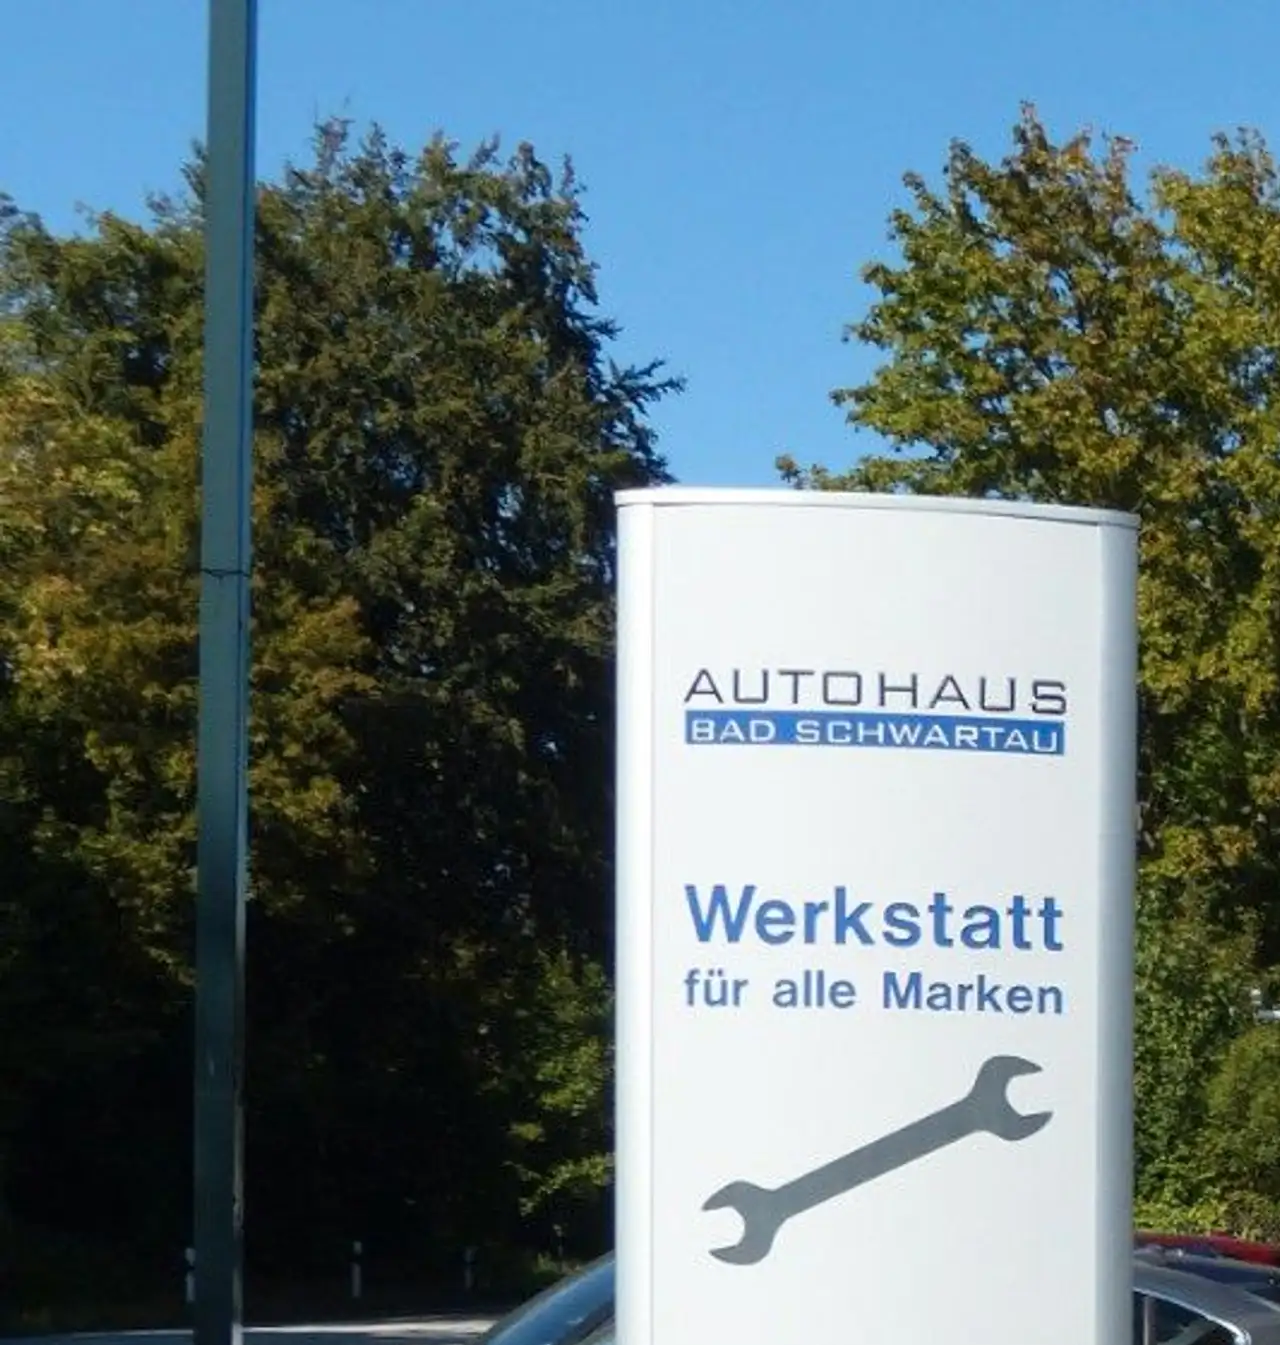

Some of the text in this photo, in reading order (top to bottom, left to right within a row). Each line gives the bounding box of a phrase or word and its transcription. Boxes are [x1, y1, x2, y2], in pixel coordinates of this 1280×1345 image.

[684, 668, 1067, 716] AUTOHAUS
[690, 719, 1059, 753] BAD SCHWARTAU
[684, 884, 1064, 951] Werkstatt
[684, 968, 1064, 1015] für alle Marken
